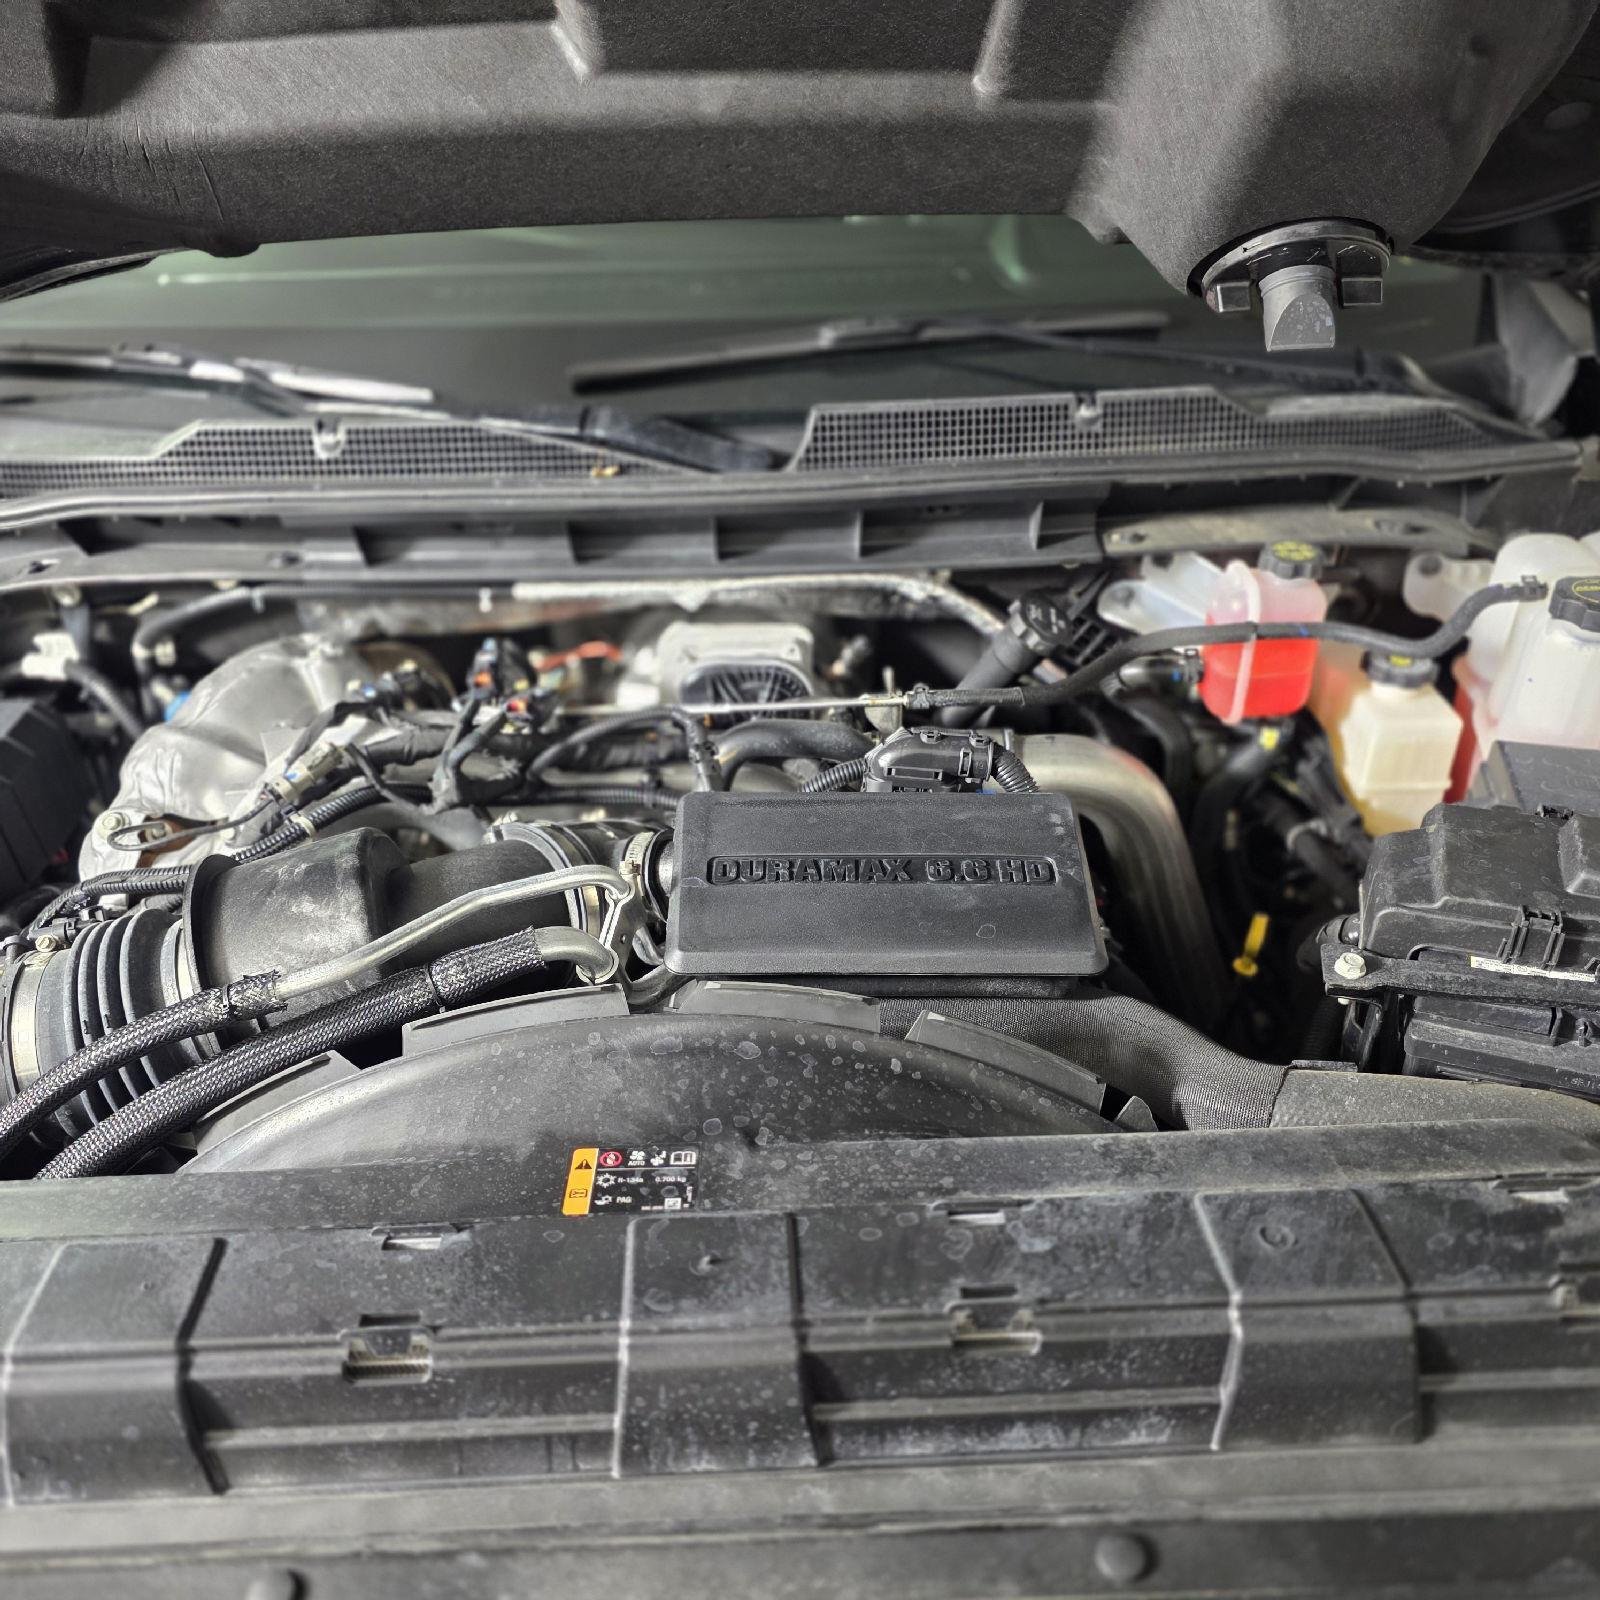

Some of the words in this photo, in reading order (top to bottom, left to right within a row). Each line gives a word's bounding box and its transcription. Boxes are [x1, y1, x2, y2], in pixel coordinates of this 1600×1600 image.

[711, 857, 913, 884] DURAMAX
[925, 858, 990, 883] 6.6
[996, 859, 1054, 884] HD
[616, 1196, 632, 1204] PAG
